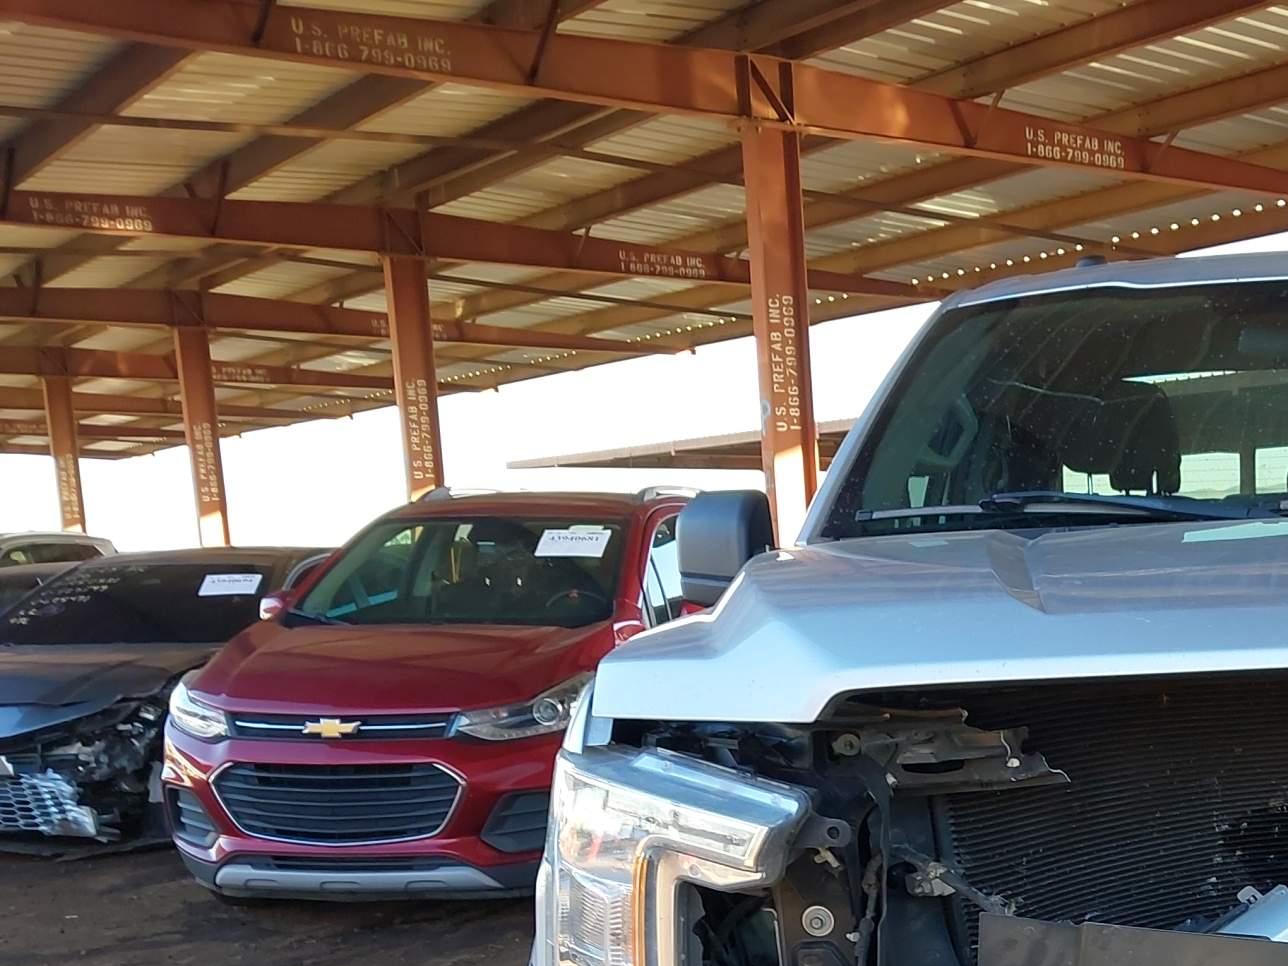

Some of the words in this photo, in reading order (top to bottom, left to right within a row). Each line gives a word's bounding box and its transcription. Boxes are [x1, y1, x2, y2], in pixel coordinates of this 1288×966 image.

[1027, 142, 1125, 169] 1-866-799-0969
[1054, 131, 1099, 151] PREFAB
[1104, 140, 1125, 156] INC.
[768, 293, 781, 324] INC.
[770, 331, 785, 393] PREFAB
[782, 295, 802, 431] 1-866-799-0969
[407, 405, 421, 451] PREFAB
